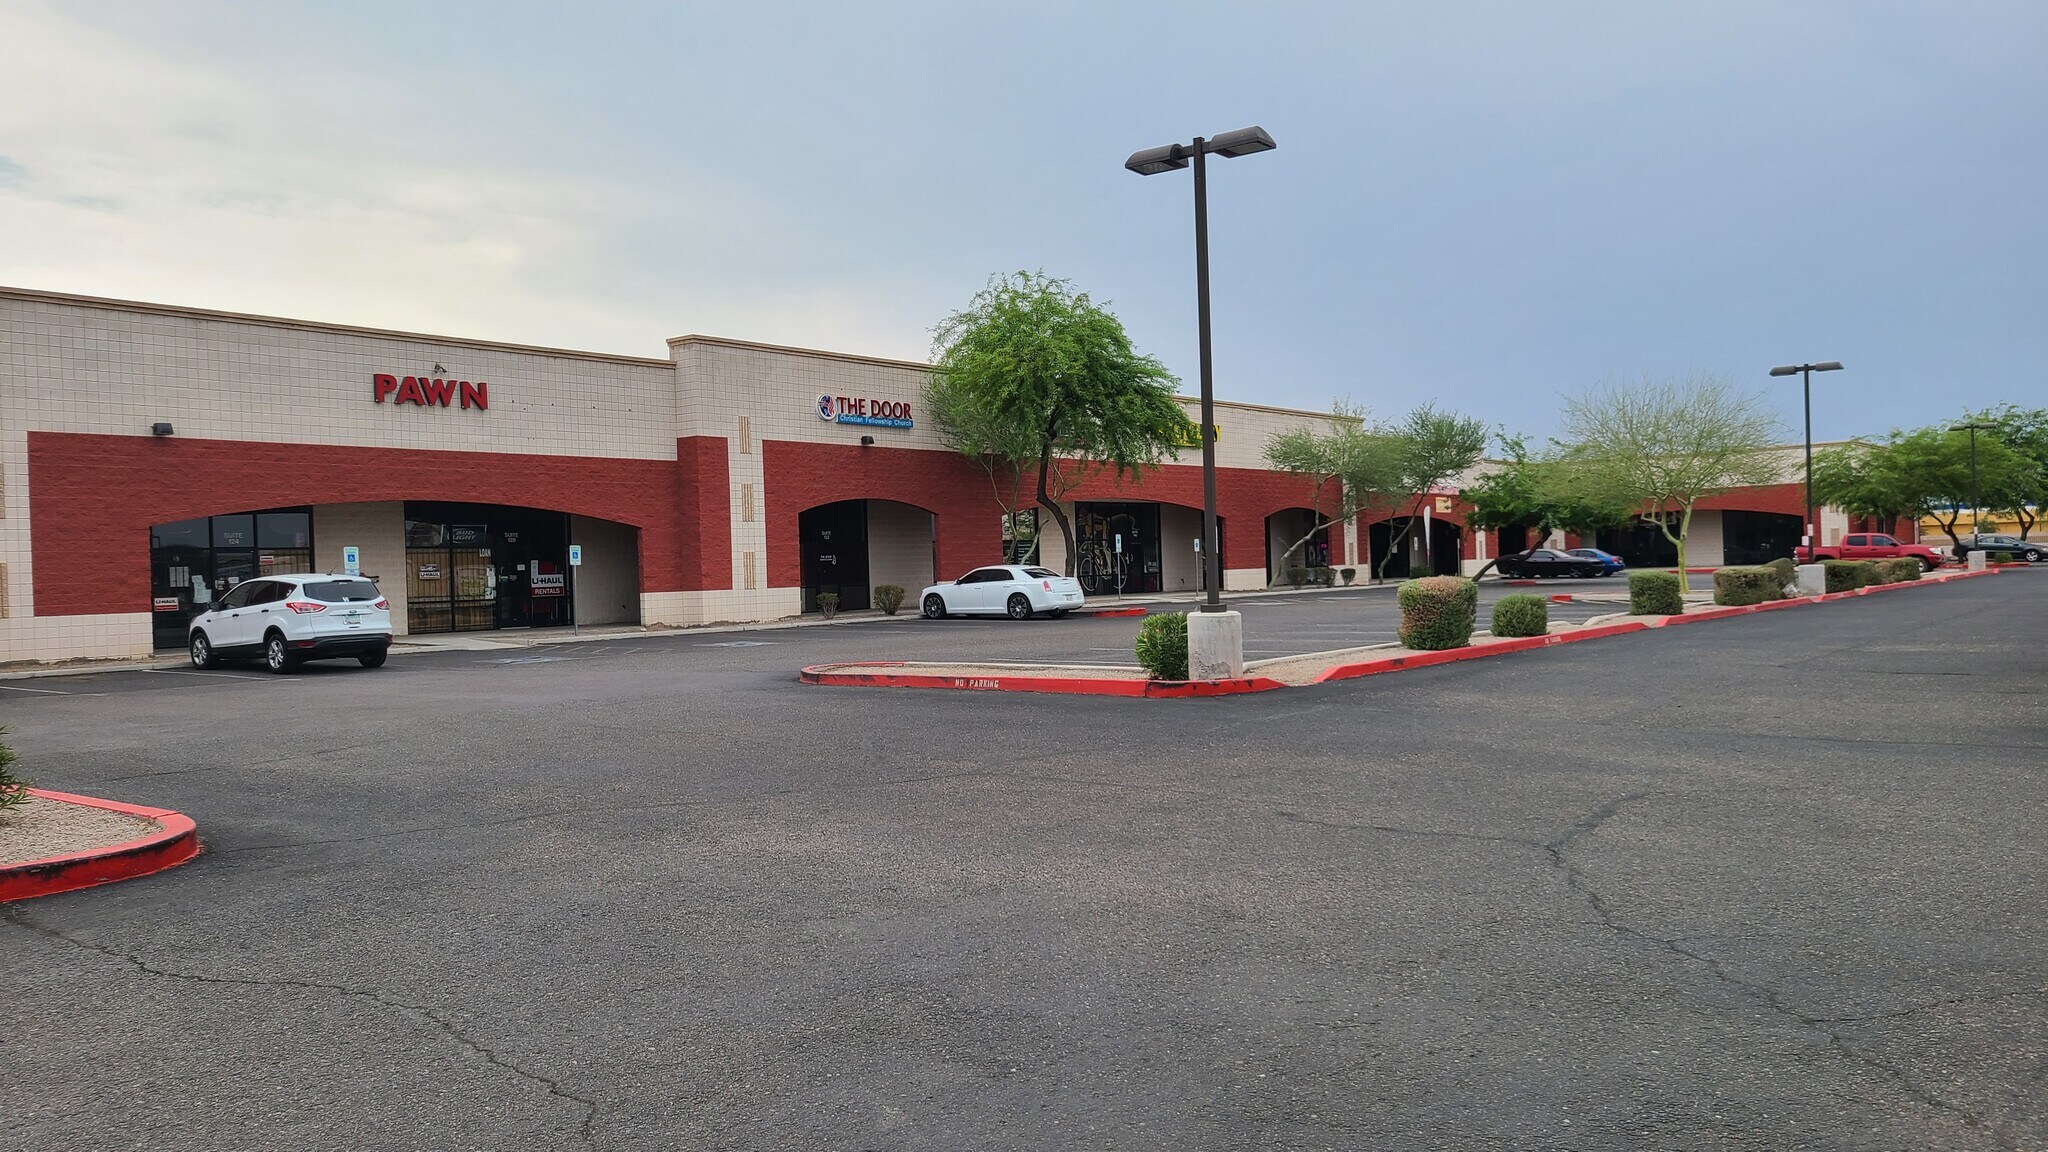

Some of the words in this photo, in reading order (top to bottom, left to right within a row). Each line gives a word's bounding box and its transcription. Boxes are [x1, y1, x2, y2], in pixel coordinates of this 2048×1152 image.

[373, 373, 488, 410] PAWN
[836, 396, 867, 415] THE
[870, 399, 912, 419] DOOR
[839, 415, 864, 423] Christian
[865, 418, 893, 427] Fellowship
[894, 419, 912, 427] Church
[479, 549, 491, 558] LOAN
[531, 577, 563, 585] U-HAUL
[534, 587, 561, 595] RENTALS
[955, 678, 964, 687] NO
[969, 679, 999, 688] PARKING
